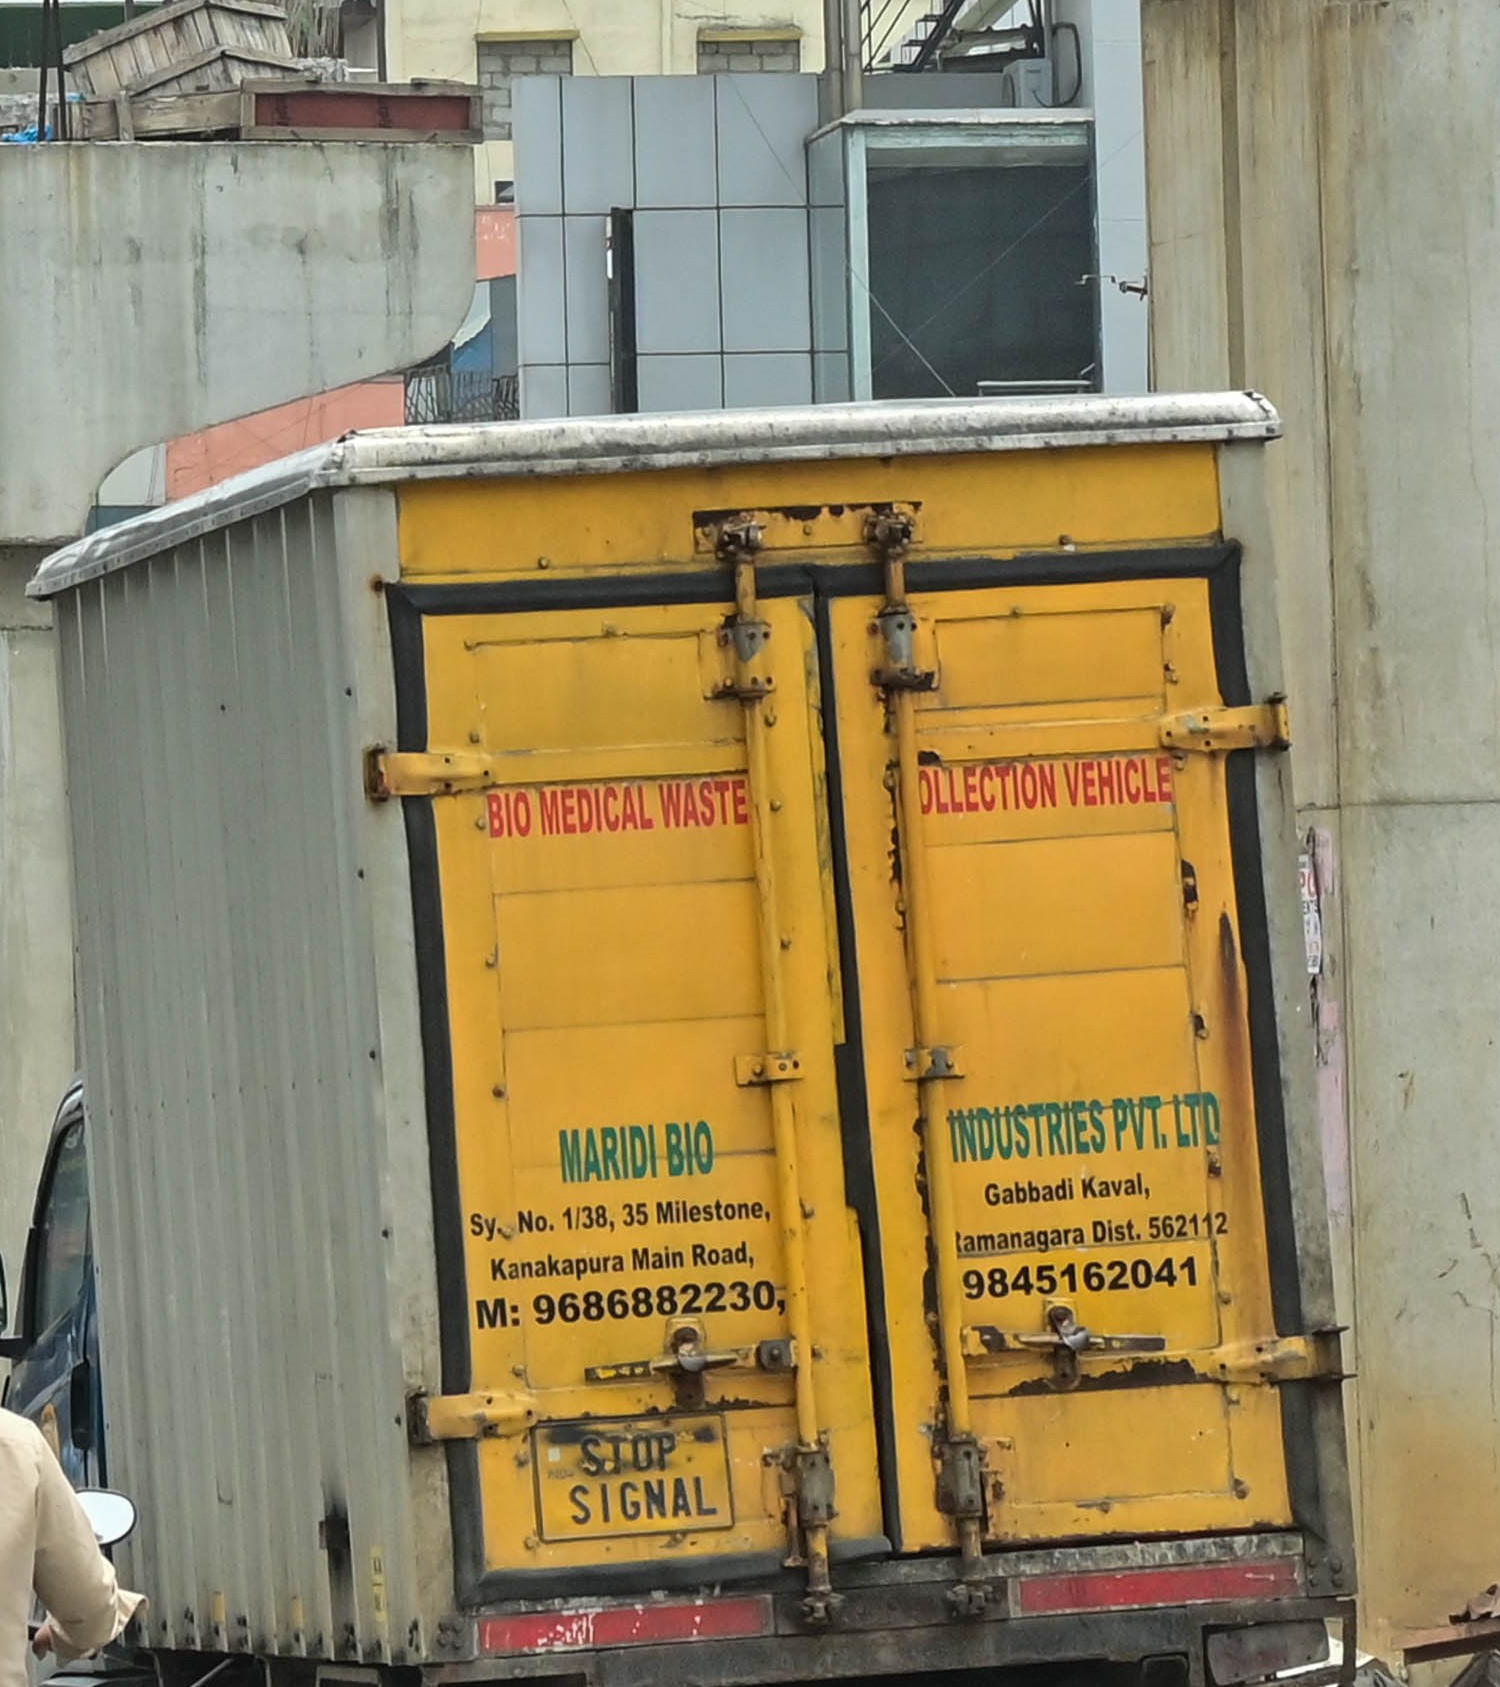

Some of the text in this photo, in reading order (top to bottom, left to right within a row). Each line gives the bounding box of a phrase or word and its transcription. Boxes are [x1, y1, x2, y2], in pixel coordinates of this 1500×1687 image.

[487, 778, 749, 839] BIO MEDICAL WASTE
[918, 755, 1174, 816] OLLECTION VEHICLE
[949, 1091, 1222, 1163] INDUSTRIES PVT. LTD
[559, 1120, 714, 1184] MARIDI BIO
[984, 1172, 1151, 1206] Gabbadi Kaval,
[517, 1210, 555, 1234] No.
[562, 1204, 616, 1234] 1/38,
[622, 1203, 649, 1227] 35
[655, 1198, 771, 1225] Milestone,
[1091, 1218, 1142, 1244] Dist.
[1148, 1211, 1229, 1240] 562112
[490, 1240, 754, 1282] Kanakapura Main Road,
[961, 1255, 1198, 1301] 9845162041
[475, 1279, 787, 1330] M: 9686882230,
[580, 1432, 677, 1478] STOP
[568, 1475, 719, 1525] SIGNAL
